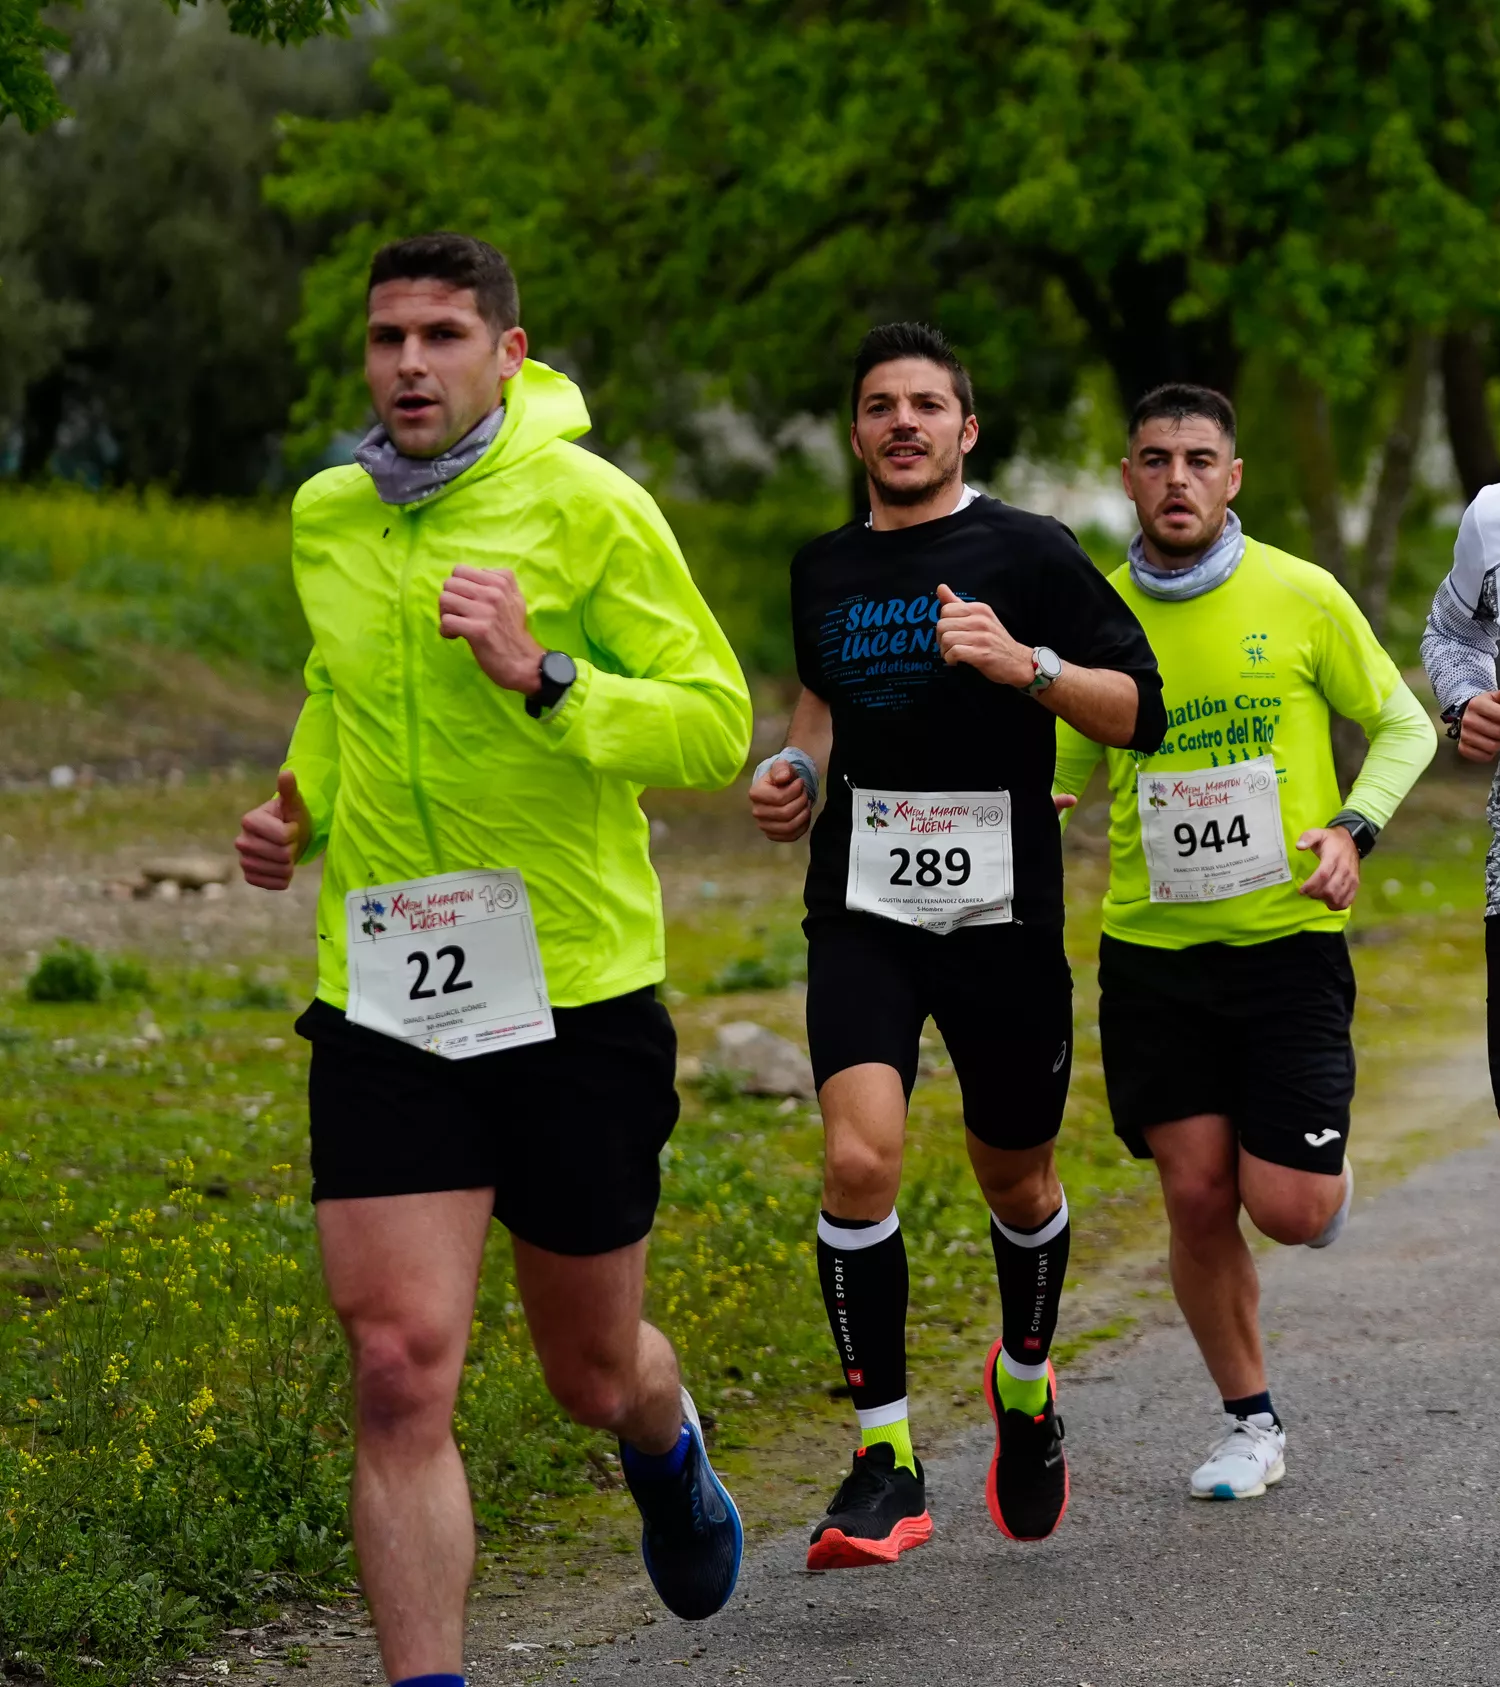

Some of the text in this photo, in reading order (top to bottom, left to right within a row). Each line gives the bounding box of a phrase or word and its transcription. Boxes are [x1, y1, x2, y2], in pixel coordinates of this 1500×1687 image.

[841, 628, 939, 662] LUCEN
[865, 660, 932, 676] atletismo
[1167, 694, 1282, 729] uatlón Cros
[1178, 729, 1222, 752] Castro
[1226, 717, 1248, 745] del
[1188, 792, 1234, 807] LUCENA
[910, 817, 959, 833] LUCENA
[1173, 814, 1251, 857] 944
[890, 847, 971, 887] 289
[407, 944, 473, 1001] 22
